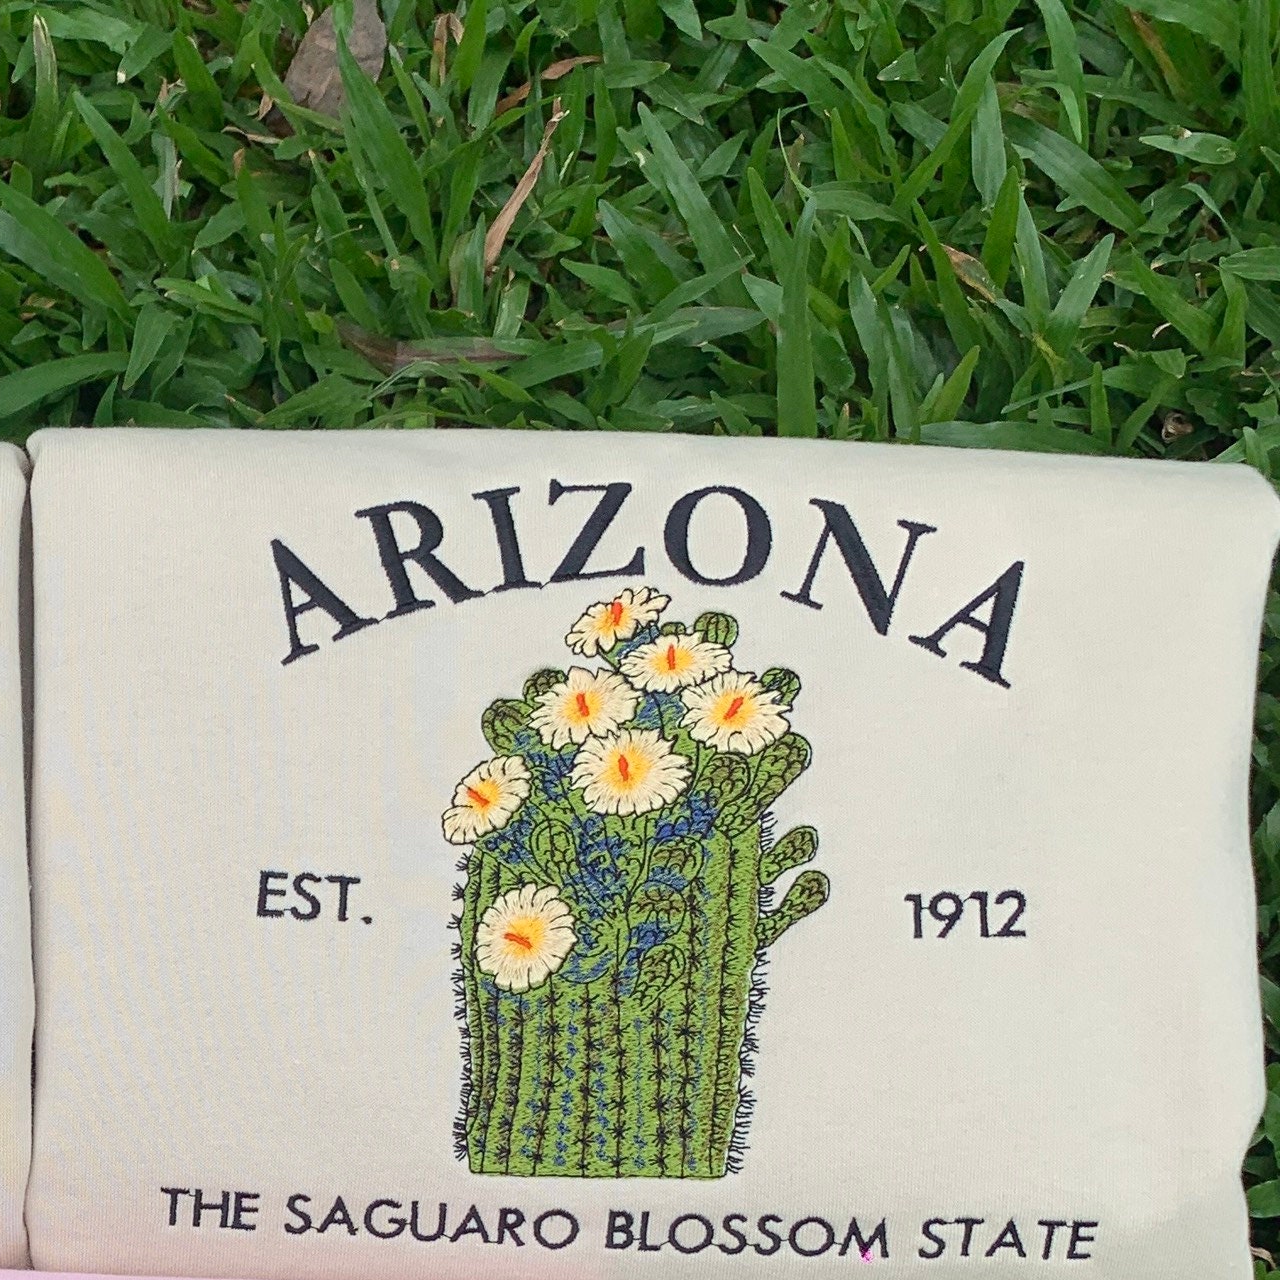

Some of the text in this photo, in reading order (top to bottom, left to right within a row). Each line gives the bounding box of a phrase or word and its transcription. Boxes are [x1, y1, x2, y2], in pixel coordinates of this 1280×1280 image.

[271, 479, 1024, 689] ARIZONA
[257, 871, 372, 924] EST.
[905, 890, 1026, 938] 1912
[161, 1187, 1098, 1259] THE SAGUARO BLOSSOM STATE
